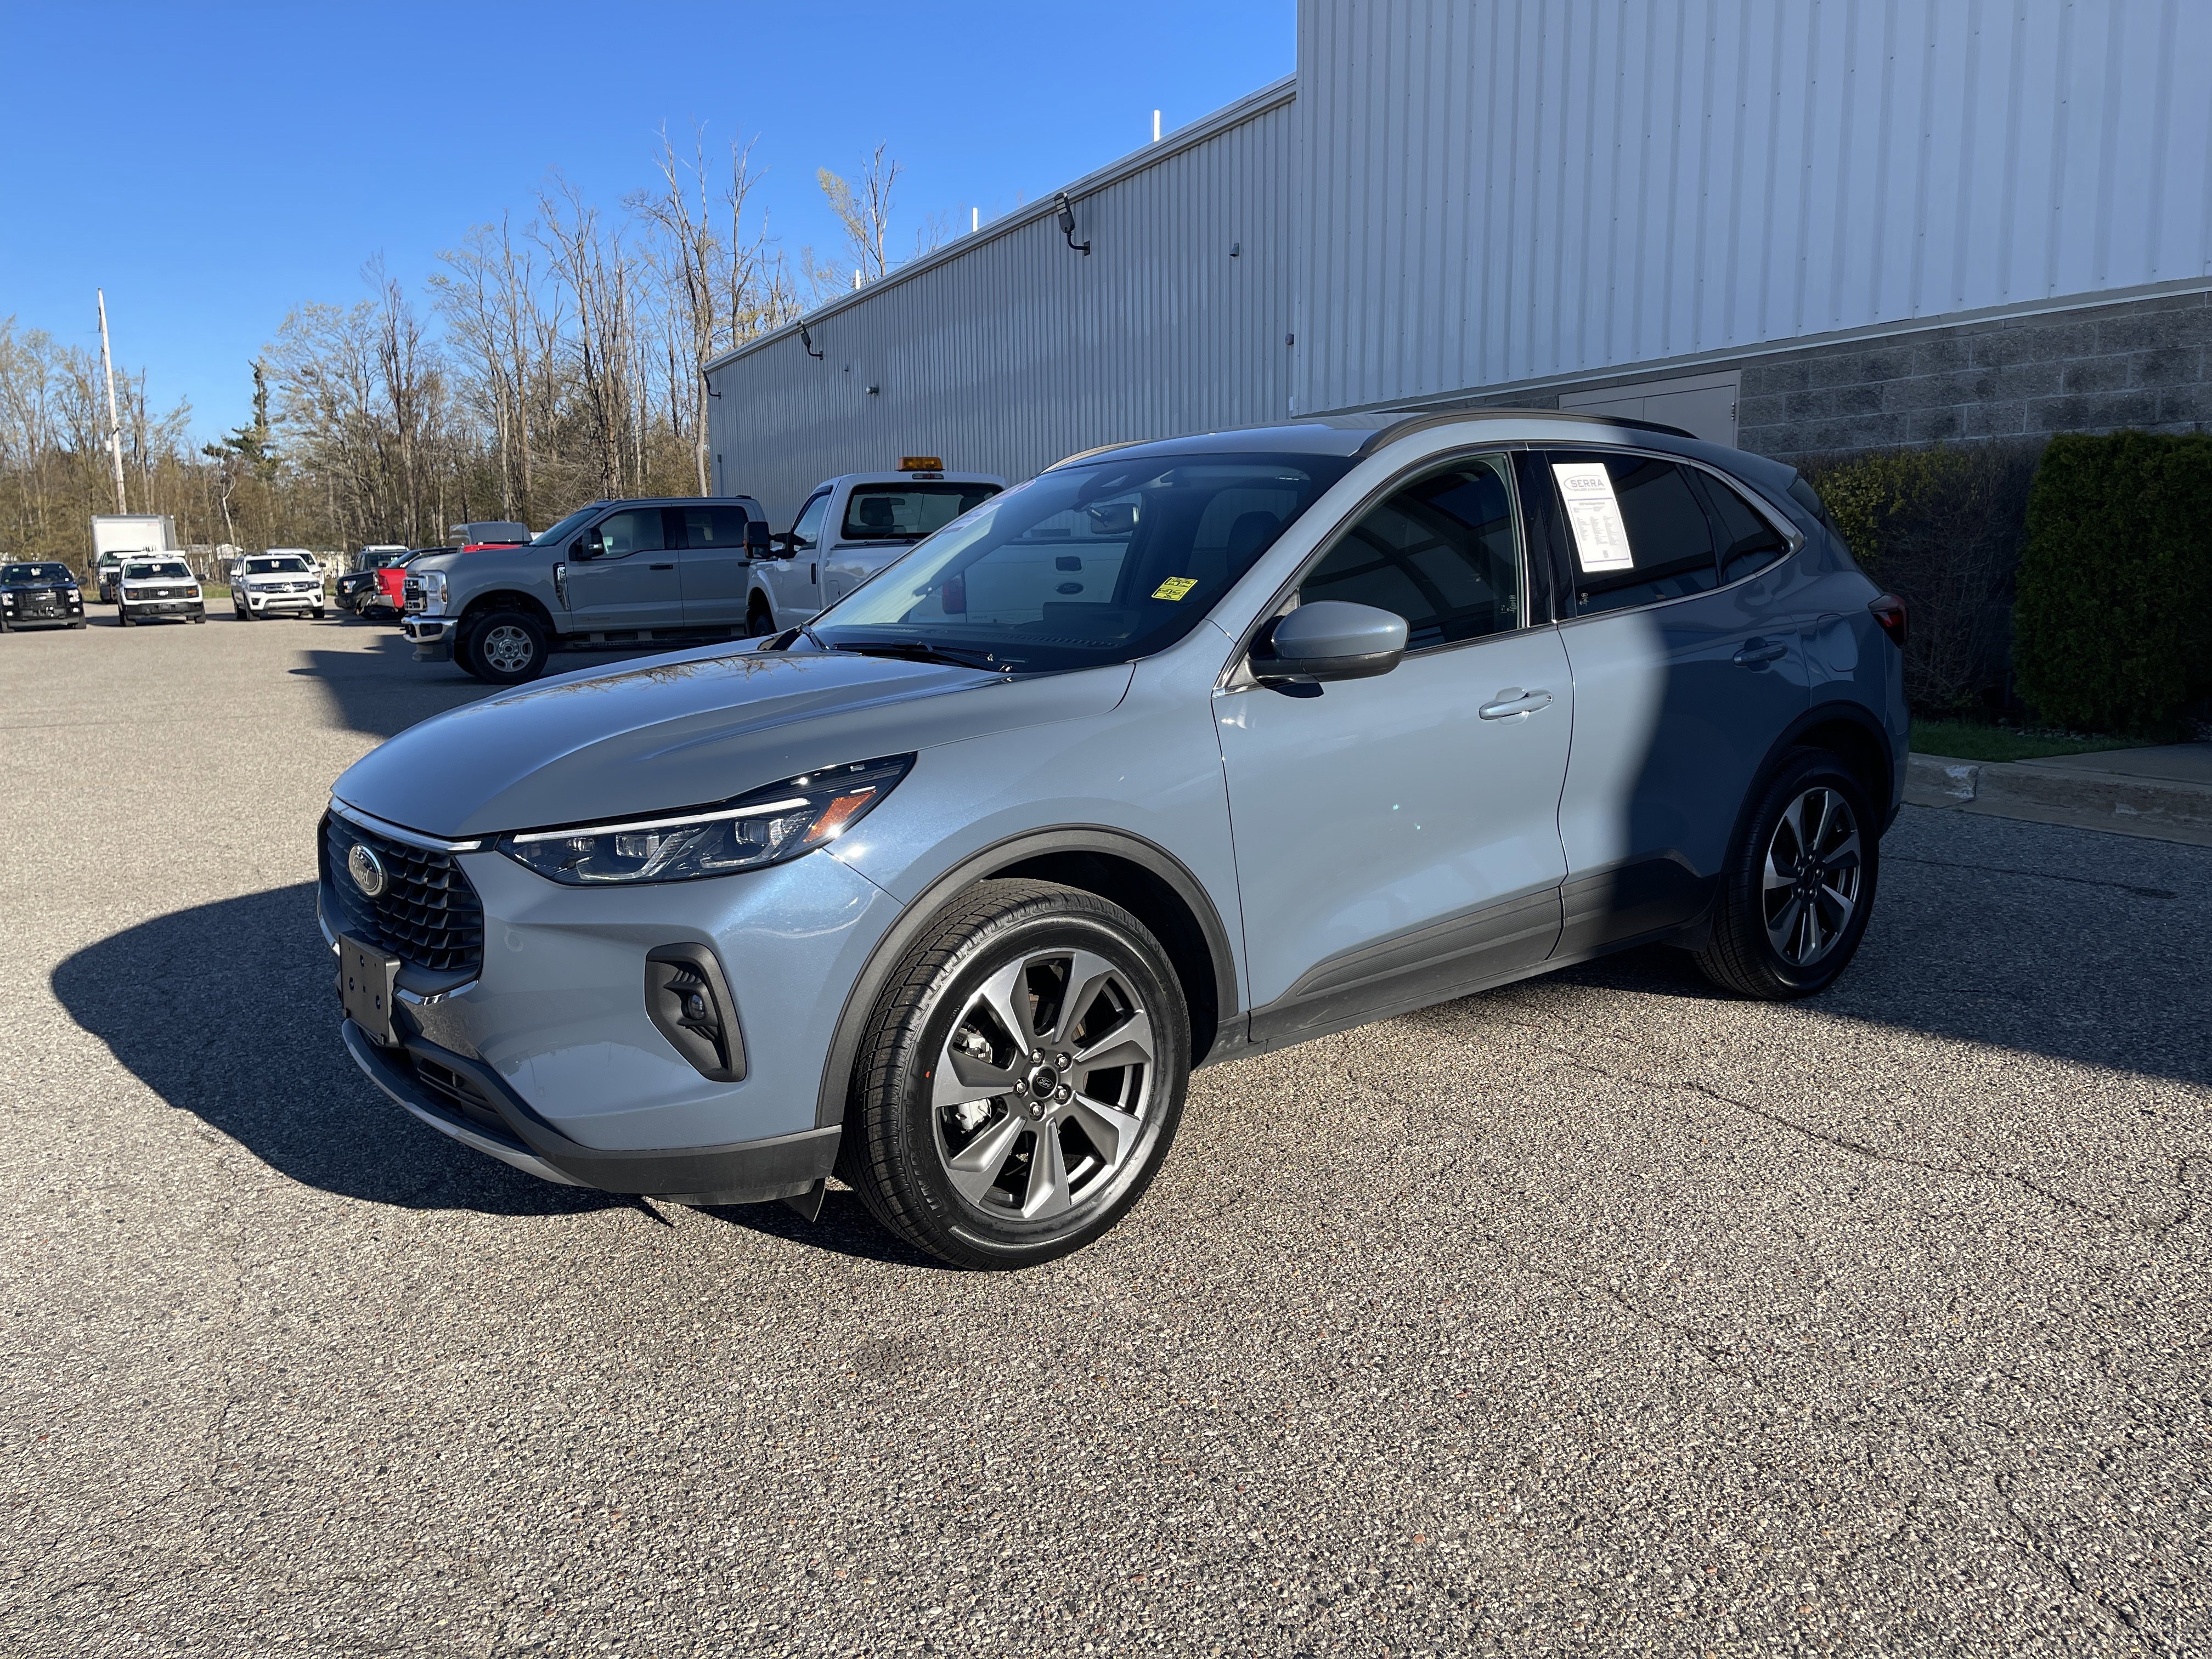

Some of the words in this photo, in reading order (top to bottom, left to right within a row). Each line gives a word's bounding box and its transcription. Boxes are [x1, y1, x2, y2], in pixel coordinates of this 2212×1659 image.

[1571, 479, 1604, 487] SERRA
[352, 855, 370, 885] Ford
[1039, 1078, 1052, 1087] Ford
[905, 1088, 943, 1211] UNIROYAL
